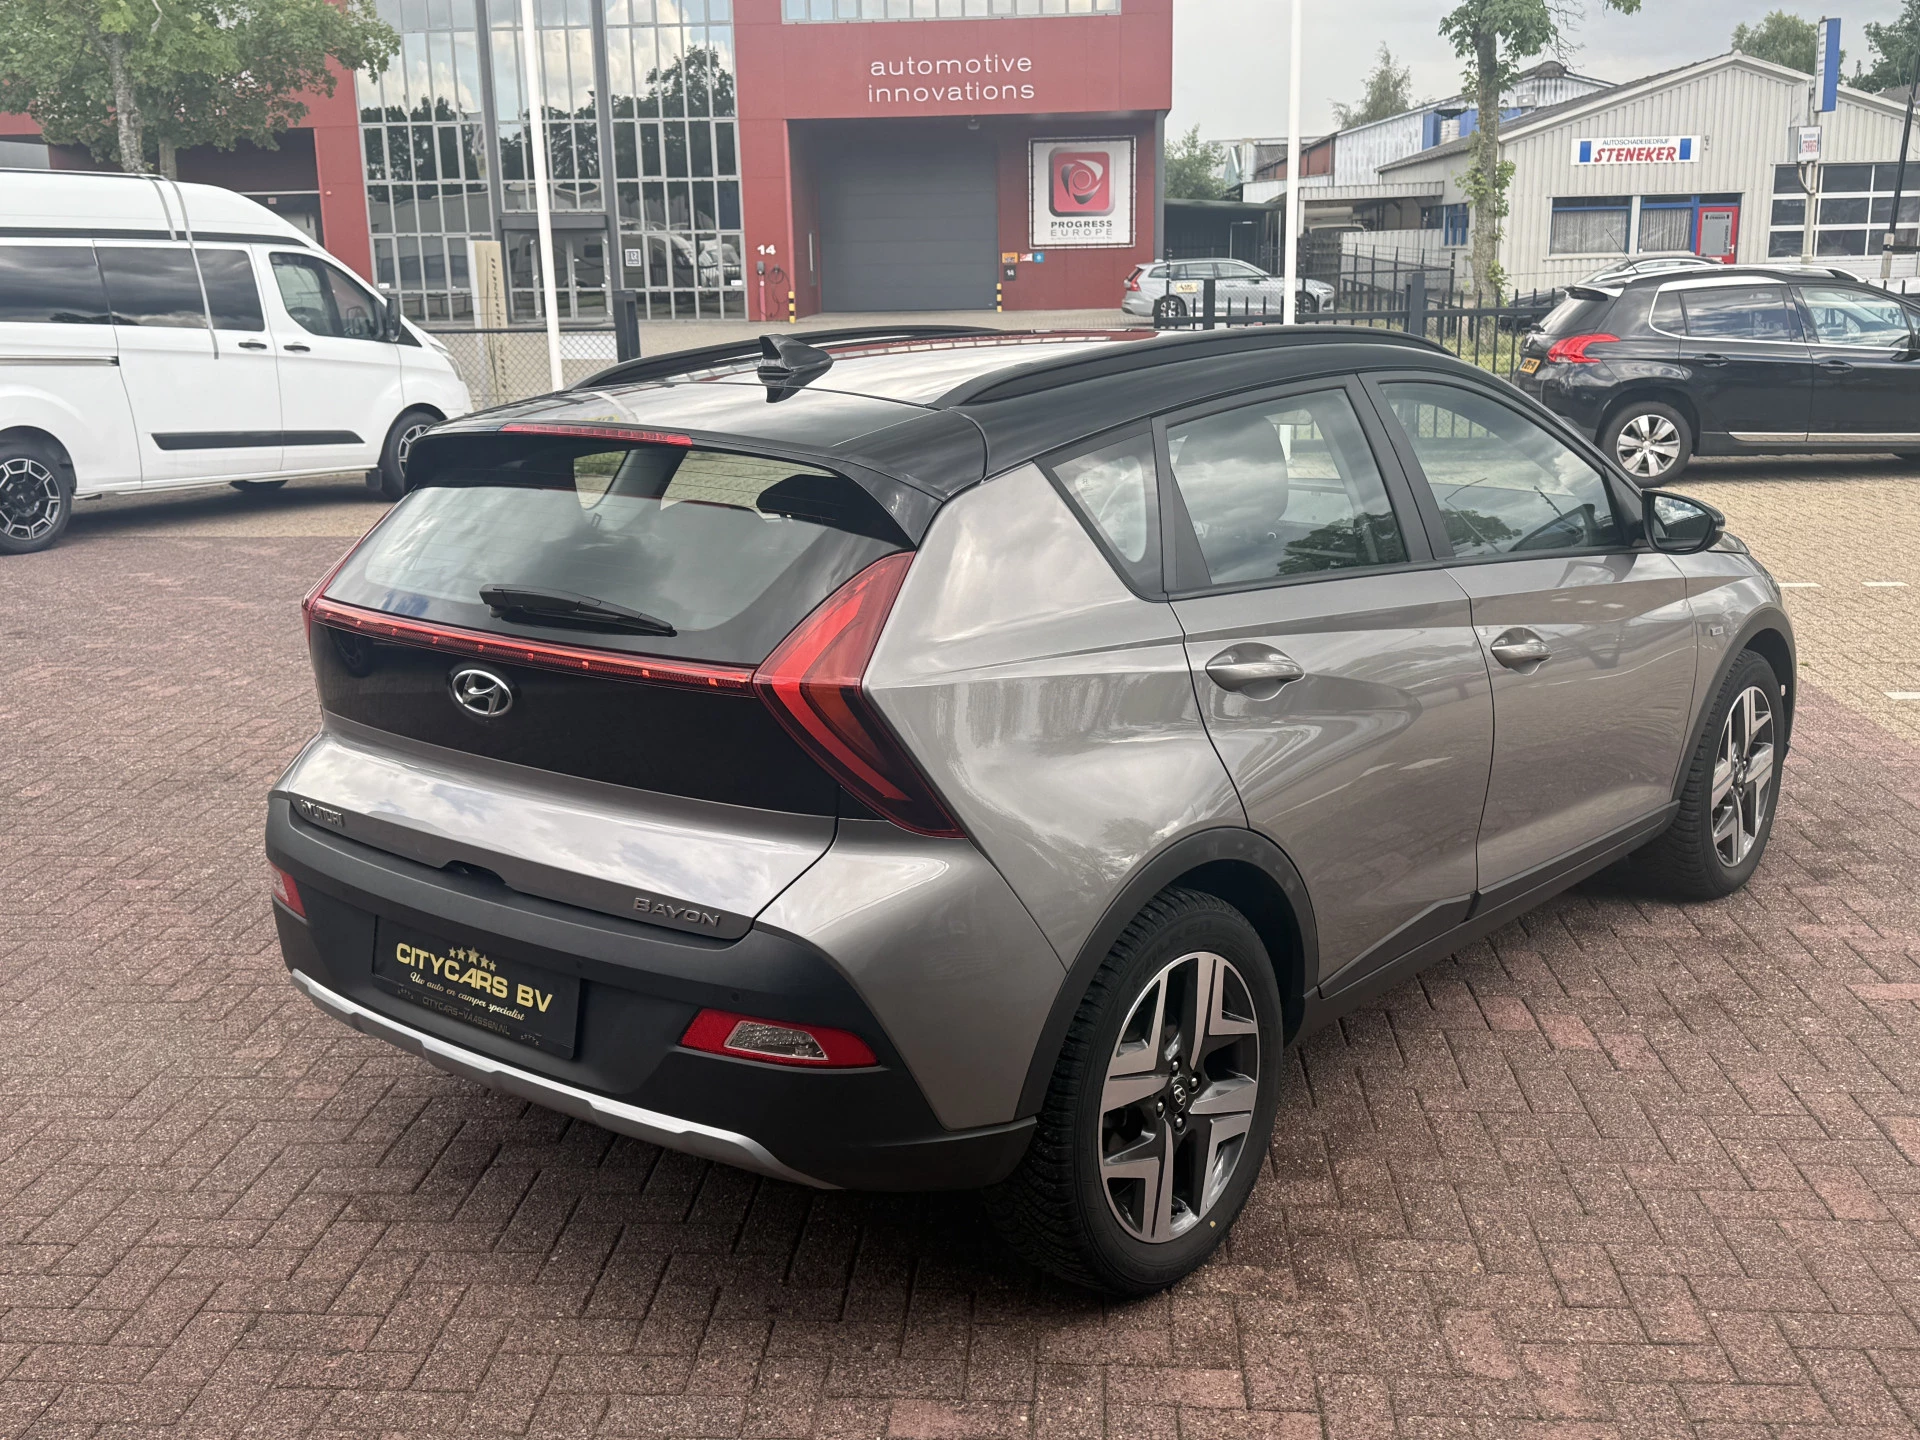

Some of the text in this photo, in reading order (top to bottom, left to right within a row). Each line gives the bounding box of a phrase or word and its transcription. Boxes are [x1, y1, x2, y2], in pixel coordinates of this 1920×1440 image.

[870, 54, 1032, 76] automotive
[868, 82, 1035, 102] innovations
[1594, 147, 1677, 163] STENEKER
[1050, 229, 1113, 237] EUROPE
[1051, 220, 1113, 229] PROGRESS
[757, 244, 776, 255] 14
[300, 799, 344, 828] HYUNDAI
[633, 897, 719, 928] BAYON
[396, 942, 553, 1013] CITYCARS BV
[427, 981, 444, 992] auto
[446, 988, 456, 997] en
[458, 992, 487, 1008] camper
[488, 1002, 525, 1021] specialist
